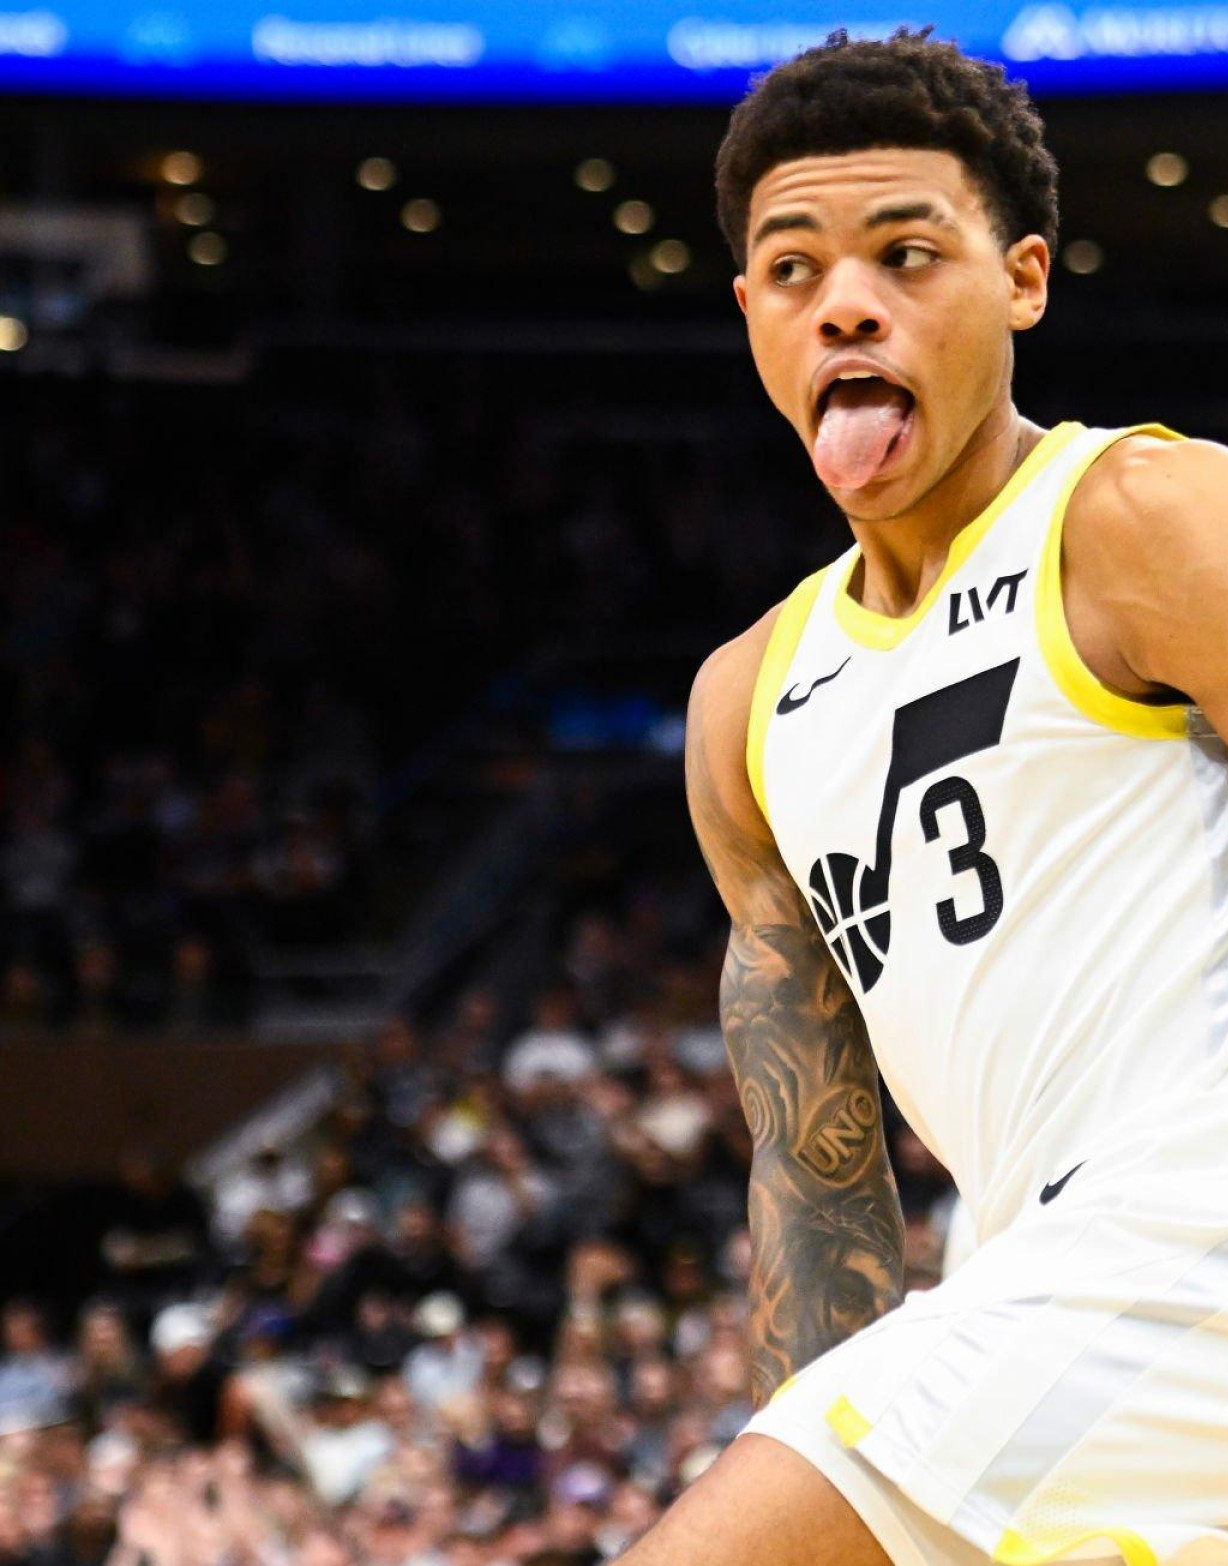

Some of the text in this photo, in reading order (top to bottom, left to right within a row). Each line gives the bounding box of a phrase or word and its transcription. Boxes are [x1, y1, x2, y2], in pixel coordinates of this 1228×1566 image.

[948, 567, 1029, 637] LVT
[918, 775, 1005, 946] 3
[800, 1086, 877, 1176] UNO
